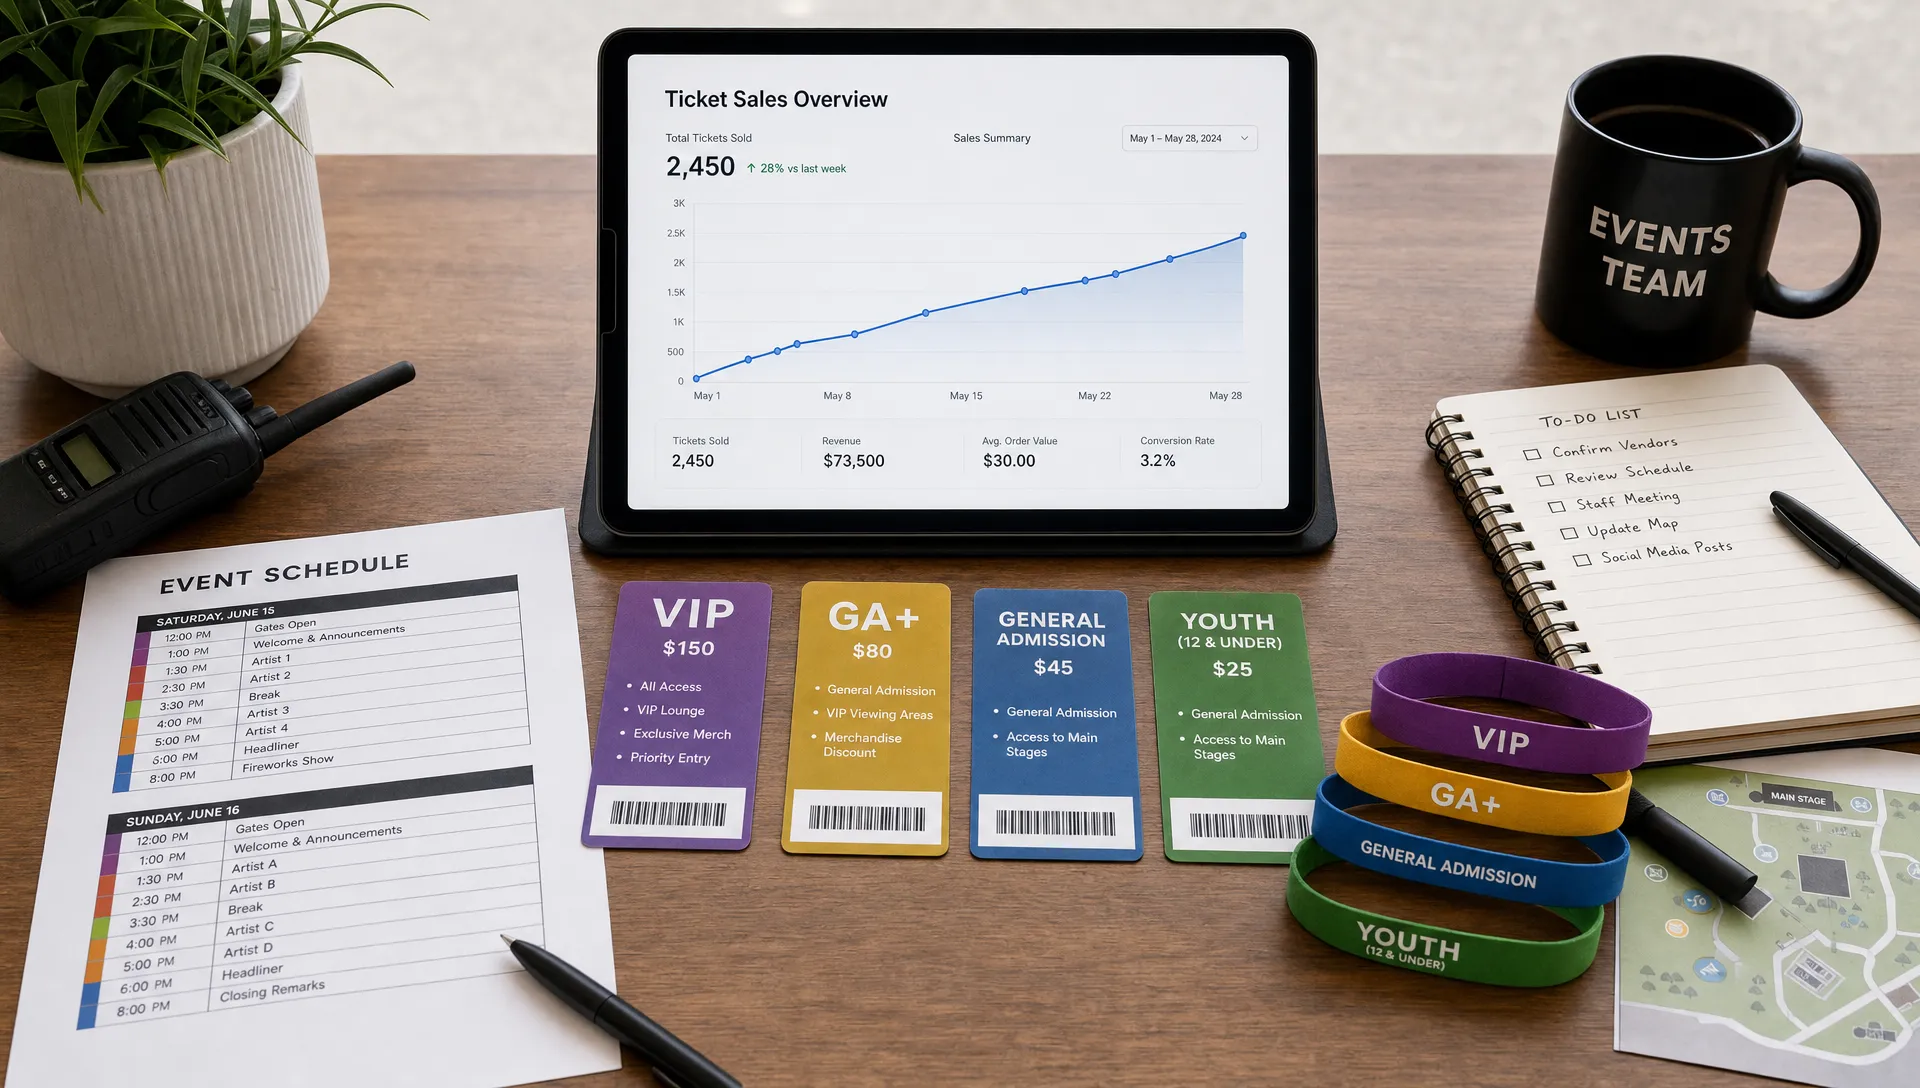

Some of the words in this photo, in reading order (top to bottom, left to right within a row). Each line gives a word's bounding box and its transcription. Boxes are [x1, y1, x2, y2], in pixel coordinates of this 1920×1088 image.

[665, 90, 727, 107] Ticket
[734, 90, 787, 108] Sales
[794, 90, 888, 107] Overview
[665, 133, 689, 143] Total
[692, 133, 728, 143] Tickets
[731, 133, 752, 143] Sold
[954, 133, 981, 143] Sales
[983, 133, 1031, 145] Summary
[1130, 134, 1148, 144] May
[1165, 134, 1183, 144] May
[1185, 134, 1199, 144] 28,
[1201, 134, 1222, 142] 2024
[667, 156, 735, 180] 2,450
[761, 163, 784, 173] 28%
[801, 164, 818, 173] last
[821, 164, 846, 173] week
[673, 199, 685, 207] 3K
[667, 229, 685, 237] 2.5K
[1590, 206, 1732, 255] EVENTS
[674, 259, 685, 267] 2K
[1603, 255, 1707, 297] TEAM
[668, 288, 685, 296] 1.5K
[673, 318, 684, 326] 1K
[667, 347, 684, 356] 500
[694, 391, 713, 402] May
[824, 391, 843, 402] May
[845, 391, 852, 400] 8
[950, 391, 969, 402] May
[973, 391, 983, 400] 15
[1079, 391, 1098, 402] May
[1100, 391, 1111, 400] 22
[1210, 391, 1229, 402] May
[1231, 391, 1242, 400] 28
[1539, 413, 1596, 428] TO-DO
[1606, 408, 1641, 421] LIST
[673, 436, 706, 445] Tickets
[709, 436, 729, 445] Sold
[822, 437, 861, 445] Revenue
[982, 437, 1002, 447] Avg.
[1005, 436, 1031, 445] Order
[1033, 437, 1058, 445] Value
[1140, 436, 1192, 445] Conversion
[1195, 436, 1215, 445] Rate
[1553, 444, 1612, 457] Confirm
[1618, 438, 1678, 450] Vendors
[672, 454, 714, 469] 2,450
[824, 453, 884, 469] $73,500
[984, 453, 1035, 468] $30.00
[1141, 454, 1176, 467] 3.2%
[1565, 472, 1617, 484] Review
[1625, 462, 1694, 477] Schedule
[1577, 496, 1615, 510] Staff
[1624, 492, 1680, 505] Meeting
[1587, 523, 1641, 540] Update
[1648, 518, 1678, 532] Map
[1601, 549, 1642, 563] Social
[1646, 545, 1690, 558] Media
[1694, 541, 1733, 553] Posts
[160, 570, 252, 595] EVENT
[264, 554, 409, 582] SCHEDULE
[156, 612, 224, 626] SATURDAY,
[227, 608, 258, 619] JUNE
[262, 606, 275, 615] 15
[653, 598, 734, 628] VIP
[829, 601, 919, 631] GA+
[999, 611, 1105, 628] GENERAL
[255, 624, 284, 632] Gates
[288, 620, 316, 630] Open
[1180, 613, 1274, 630] YOUTH
[165, 632, 192, 642] 12:00
[196, 630, 211, 639] PM
[253, 638, 304, 649] Welcome
[307, 634, 316, 643] &
[319, 626, 405, 641] Announcements
[997, 633, 1105, 647] ADMISSION
[1178, 635, 1200, 649] (12
[1204, 636, 1217, 648] &
[1220, 637, 1282, 651] UNDER)
[168, 649, 190, 658] 1:00
[194, 647, 209, 655] PM
[663, 639, 714, 657] $150
[853, 642, 892, 659] $80
[1034, 658, 1073, 676] $45
[1213, 660, 1252, 678] $25
[640, 681, 656, 691] All
[659, 681, 702, 692] Access
[828, 684, 872, 695] General
[875, 685, 936, 696] Admission
[637, 705, 658, 715] VIP
[661, 705, 705, 718] Lounge
[827, 708, 847, 718] VIP
[850, 708, 896, 722] Viewing
[900, 710, 933, 720] Areas
[1007, 707, 1052, 717] General
[1055, 707, 1117, 718] Admission
[1191, 709, 1237, 719] General
[1241, 709, 1302, 720] Admission
[245, 725, 276, 736] Artist
[280, 723, 288, 732] 4
[634, 728, 689, 739] Exclusive
[693, 729, 731, 739] Merch
[155, 736, 180, 746] 5:00
[184, 734, 200, 743] PM
[825, 732, 902, 743] Merchandise
[1006, 732, 1049, 742] Access
[1052, 733, 1065, 742] to
[1068, 732, 1098, 743] Main
[1193, 734, 1236, 745] Access
[1239, 735, 1252, 745] to
[1256, 735, 1286, 745] Main
[1473, 725, 1529, 755] VIP
[631, 752, 675, 765] Priority
[678, 753, 711, 766] Entry
[824, 746, 876, 758] Discount
[1006, 746, 1047, 760] Stages
[1194, 749, 1236, 762] Stages
[243, 759, 298, 773] Fireworks
[302, 756, 334, 765] Show
[149, 773, 175, 783] 8:00
[180, 771, 196, 780] PM
[1431, 782, 1500, 813] GA+
[1771, 792, 1795, 801] MAIN
[1797, 795, 1826, 805] STAGE
[126, 812, 183, 827] SUNDAY,
[187, 807, 222, 820] JUNE
[226, 805, 240, 815] 16
[236, 823, 269, 834] Gates
[273, 819, 305, 830] Open
[137, 834, 167, 846] 12:00
[172, 832, 188, 842] PM
[234, 840, 288, 854] Welcome
[292, 836, 302, 847] &
[305, 826, 402, 845] Announcements
[1361, 840, 1436, 870] GENERAL
[1440, 860, 1537, 889] ADMISSION
[228, 902, 263, 915] Break
[130, 916, 156, 928] 3:30
[162, 913, 179, 924] PM
[1356, 920, 1461, 962] YOUTH
[1366, 945, 1383, 957] (12
[1384, 949, 1395, 960] &
[1399, 949, 1445, 971] UNDER)
[220, 988, 267, 1003] Closing
[272, 980, 325, 995] Remarks
[117, 1003, 146, 1017] 8:00
[152, 1000, 170, 1011] PM
